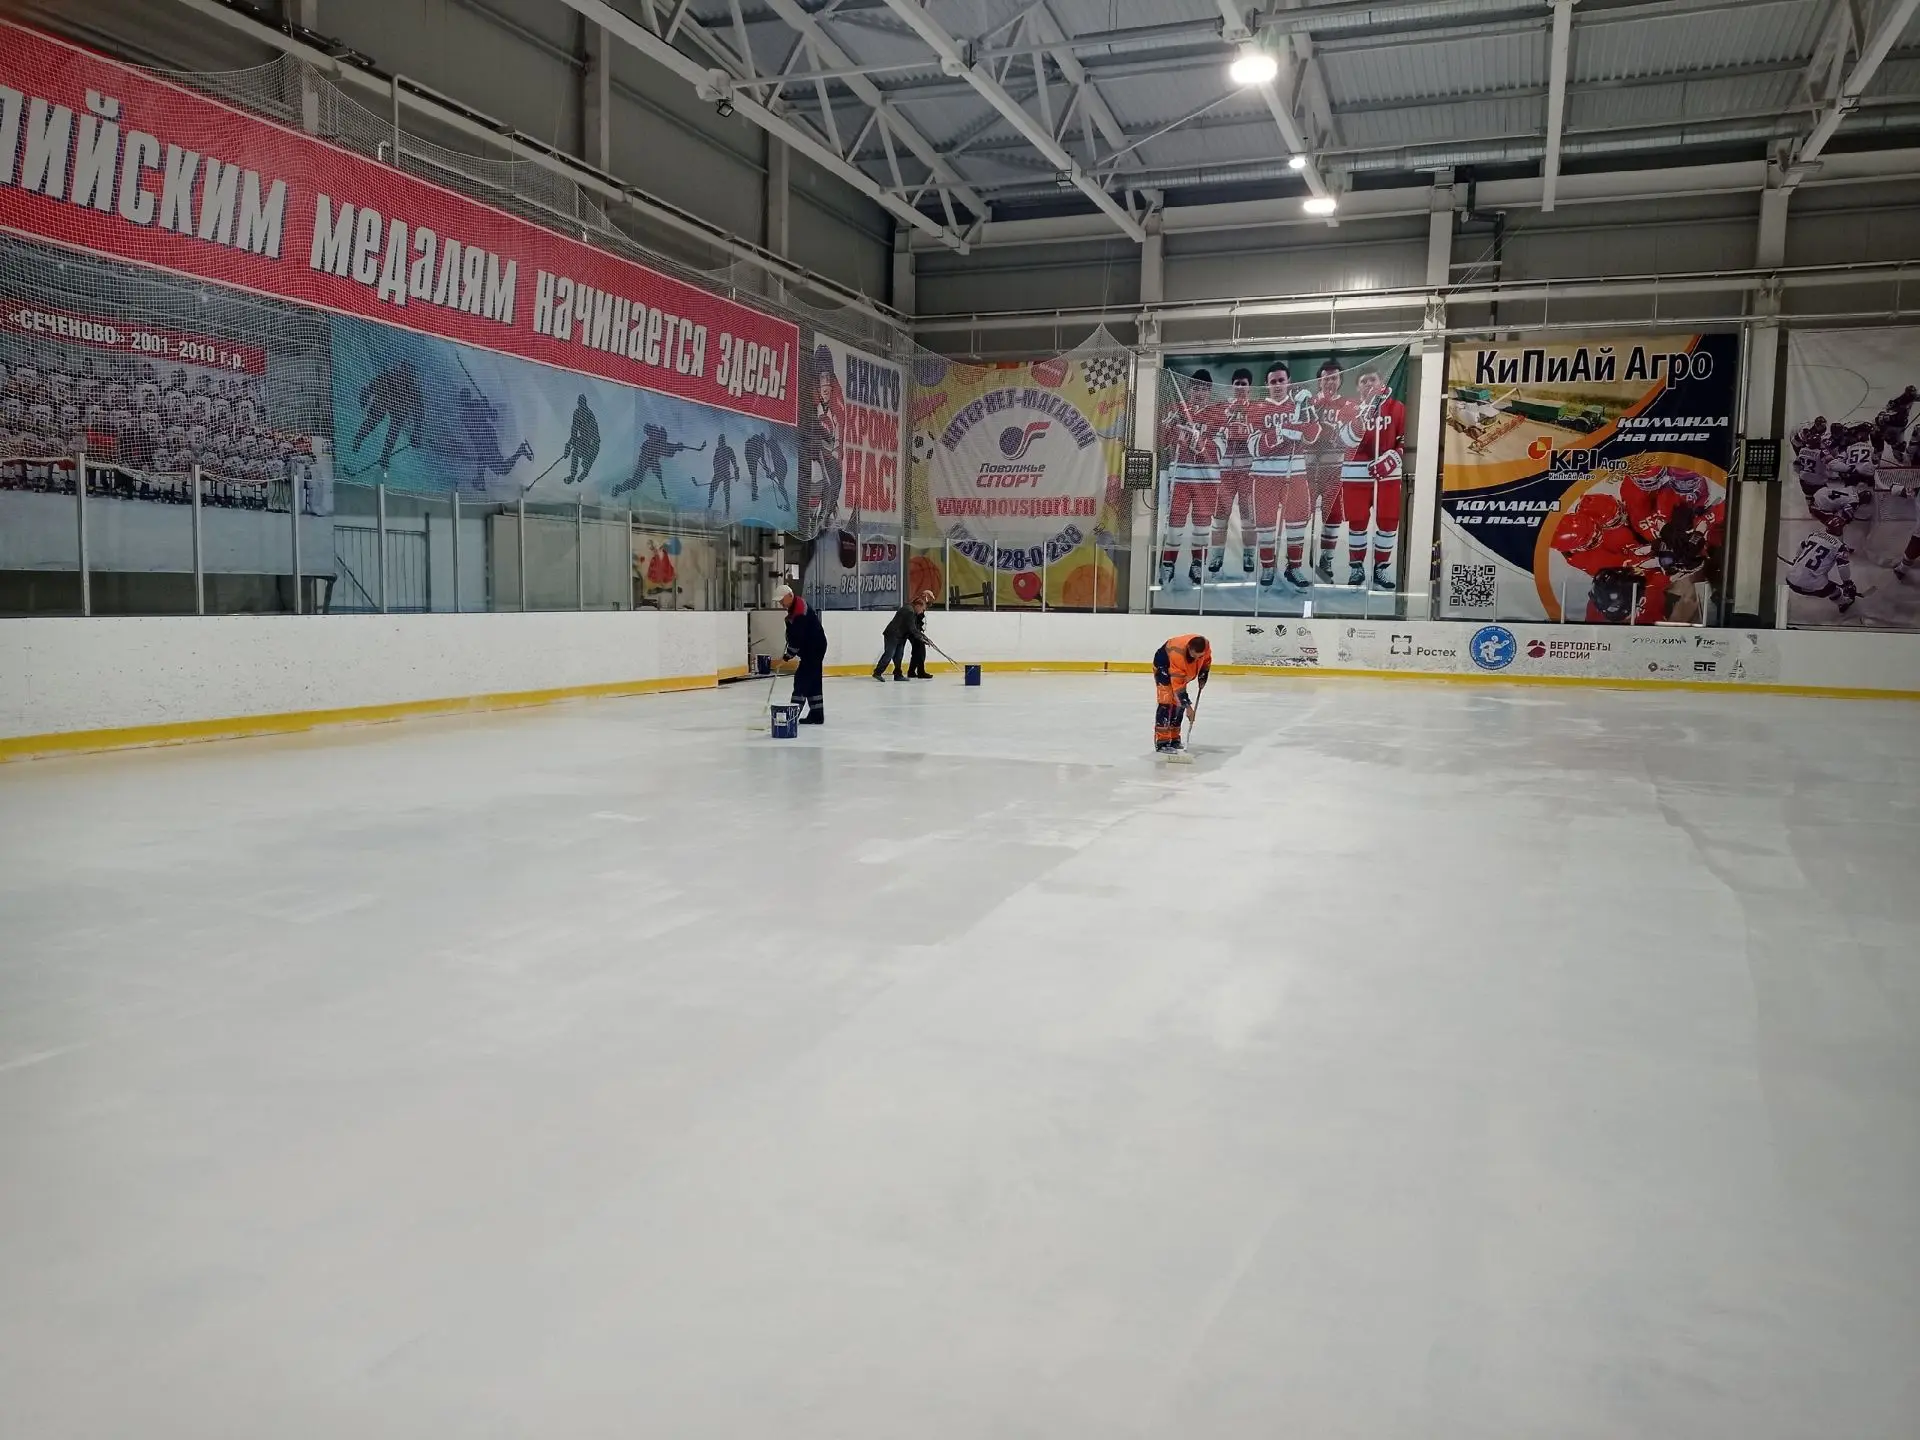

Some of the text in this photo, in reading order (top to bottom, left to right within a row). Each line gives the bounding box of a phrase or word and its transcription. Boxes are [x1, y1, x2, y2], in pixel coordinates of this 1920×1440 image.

[310, 194, 517, 324] медалям
[533, 269, 707, 377] начинается
[716, 332, 789, 400] здесь!
[1475, 345, 1713, 389] КиПиАй Агро
[846, 353, 900, 412] НИКТО
[1617, 416, 1729, 428] КОМАНДА
[1616, 432, 1710, 442] на поле
[1549, 449, 1628, 473] KPI Agro
[979, 462, 1046, 474] Поволжье
[976, 474, 1043, 488] СПОРТ
[1455, 500, 1561, 513] КОМАНДА
[1455, 514, 1541, 527] на льду
[1416, 647, 1457, 657] Ростех
[1549, 641, 1611, 652] ВЕРТОЛЕТЫ
[1549, 651, 1591, 659] РОССИИ
